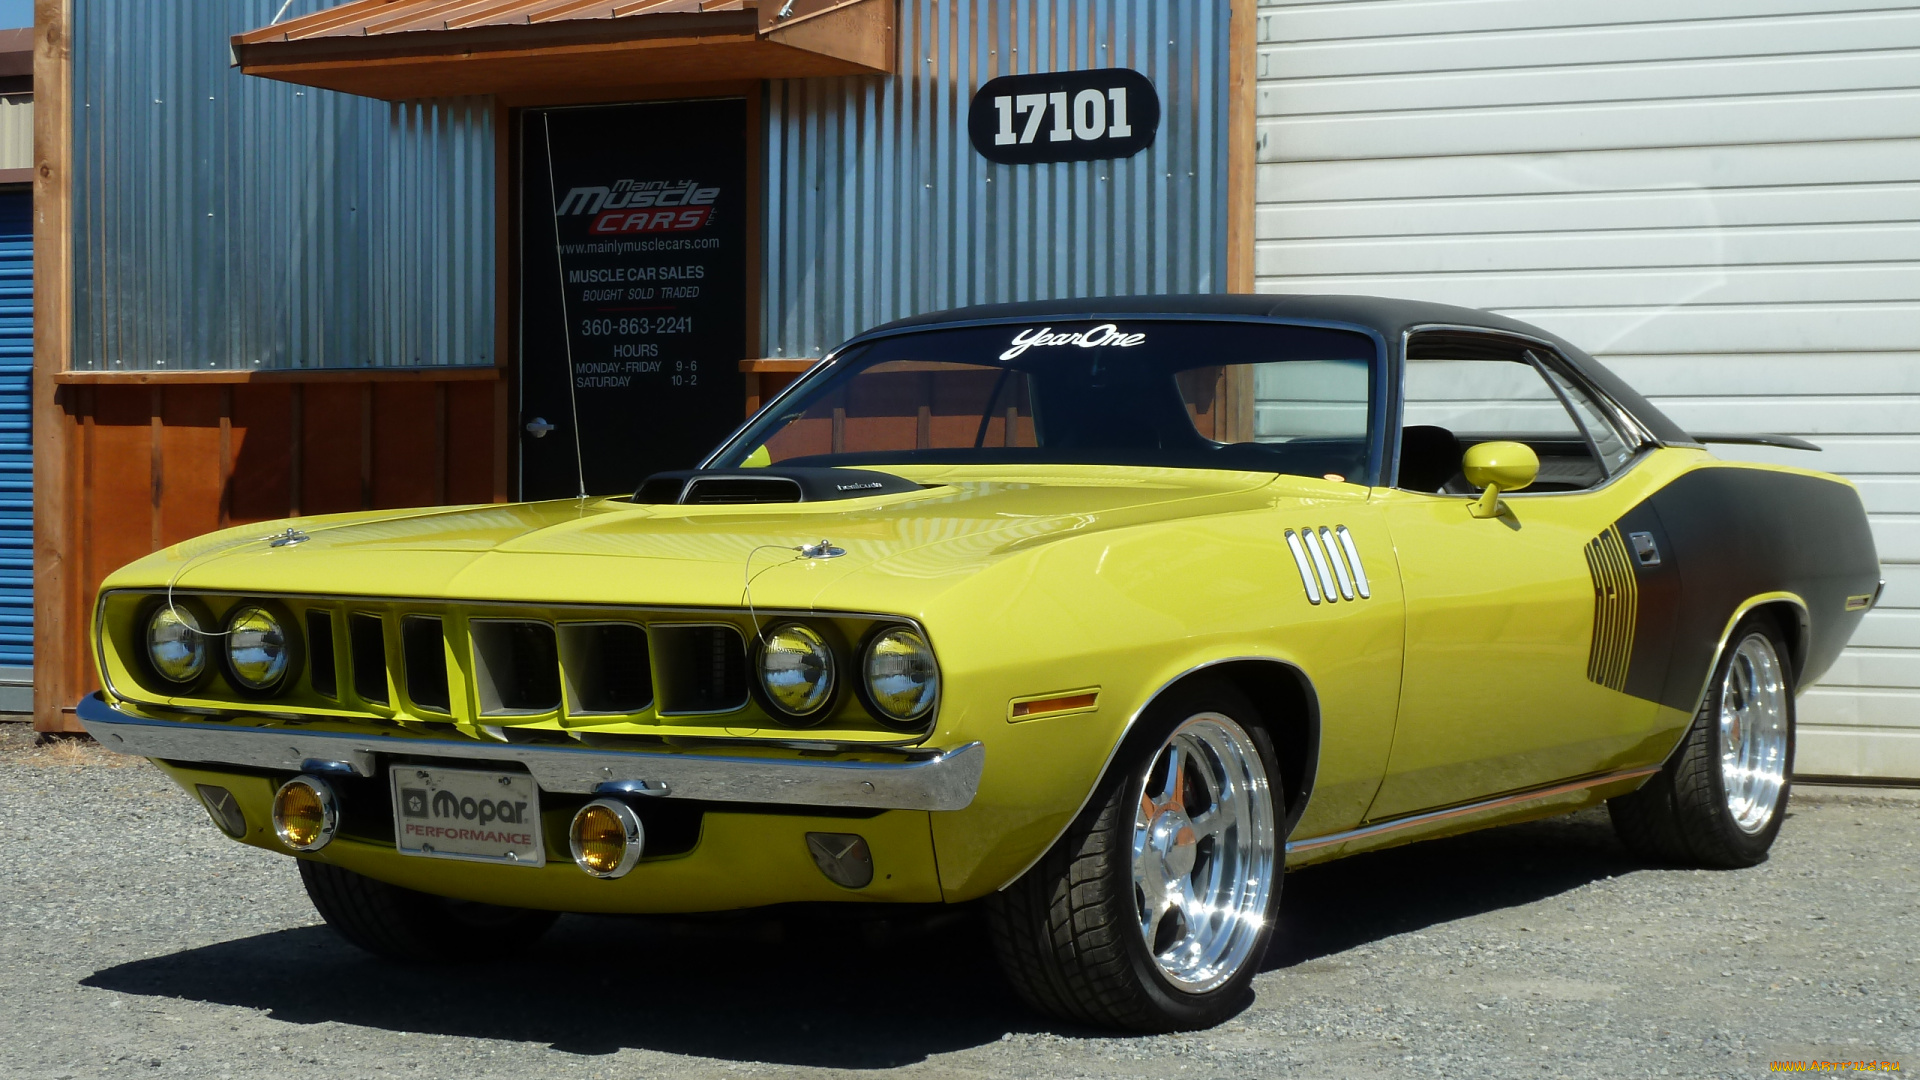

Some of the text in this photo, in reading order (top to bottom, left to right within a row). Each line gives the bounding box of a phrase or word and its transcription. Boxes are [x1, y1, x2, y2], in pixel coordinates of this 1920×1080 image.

[994, 87, 1132, 146] 17101
[597, 210, 704, 231] CARS
[556, 237, 720, 255] www.mainlymusclecars.com
[569, 265, 705, 283] MUSCLE CAR SALES
[582, 285, 700, 302] BOUGHT SOLD TRADED
[581, 316, 693, 336] 360-863-2241
[613, 343, 659, 358] HOURS
[575, 361, 662, 374] MONDAY-FRIDAY
[576, 376, 631, 388] SATURDAY
[405, 824, 532, 845] PERFORMANCE
